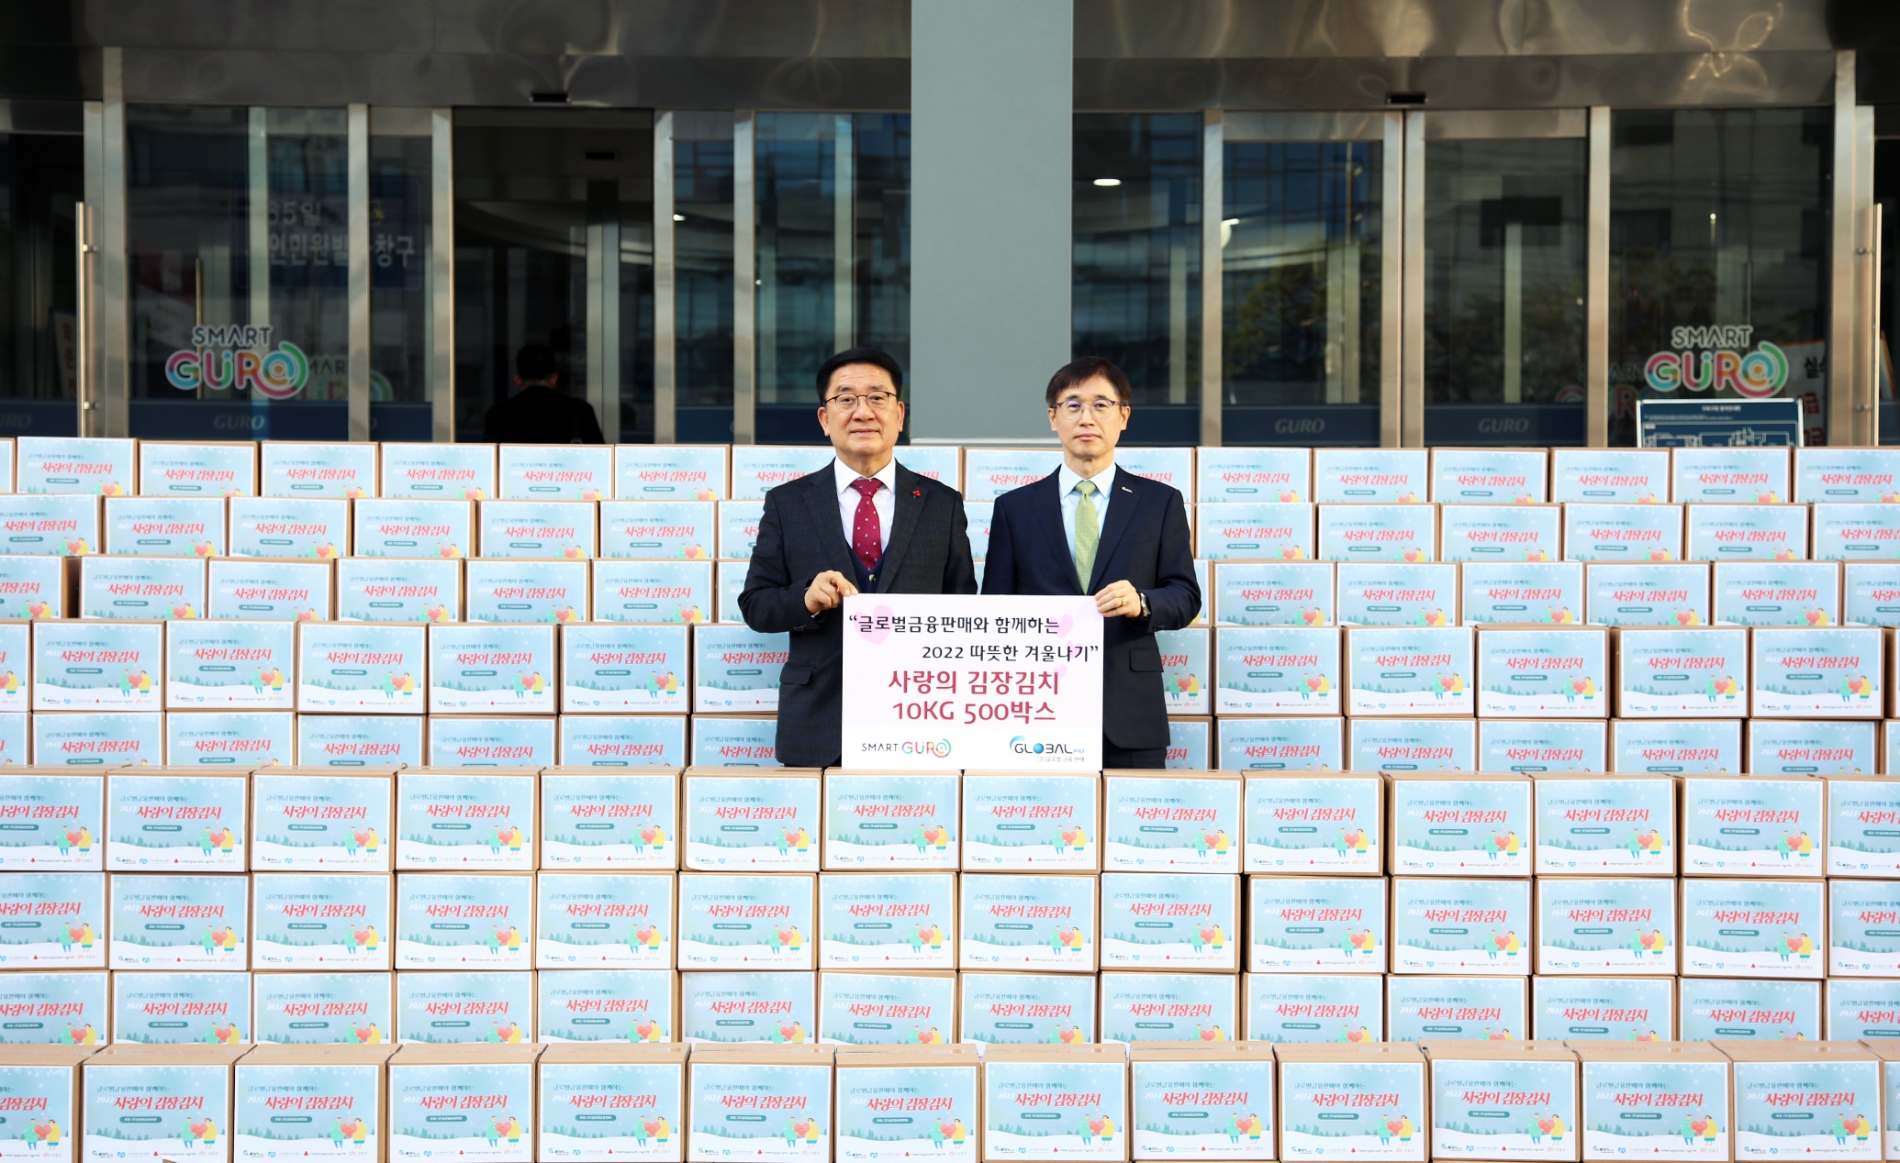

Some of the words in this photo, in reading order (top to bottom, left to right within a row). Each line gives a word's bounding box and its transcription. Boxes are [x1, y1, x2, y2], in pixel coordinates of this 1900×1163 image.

[192, 325, 273, 347] SMART
[1671, 325, 1754, 349] SMART
[213, 413, 266, 431] GURO
[1274, 417, 1326, 434] GURO
[1477, 417, 1529, 434] GURO
[849, 615, 989, 634] “글로벌금융판매와
[994, 616, 1060, 635] 함께하는
[921, 646, 964, 660] 2022
[970, 645, 1019, 662] 따뜻한
[1024, 645, 1099, 663] 겨울나기”
[888, 670, 958, 695] 사랑의
[967, 670, 1060, 696] 김장김치
[892, 700, 955, 721] 10KG
[963, 701, 1057, 725] 500박스
[861, 742, 899, 753] SMART
[137, 806, 175, 819] 사랑의
[175, 807, 223, 820] 김장김치
[427, 805, 464, 817] 사랑의
[464, 805, 511, 818] 김장김치
[570, 805, 607, 817] 사랑의
[607, 805, 653, 818] 김장김치
[854, 805, 890, 817] 사랑의
[891, 805, 937, 818] 김장김치
[991, 806, 1027, 818] 사랑의
[1028, 806, 1074, 819] 김장김치
[1273, 808, 1309, 821] 사랑의
[1310, 808, 1357, 821] 김장김치
[1423, 810, 1461, 823] 사랑의
[1461, 811, 1508, 824] 김장김치
[1715, 810, 1752, 822] 사랑의
[1753, 810, 1800, 823] 김장김치
[140, 906, 177, 918] 사랑의
[177, 906, 225, 919] 김장김치
[426, 905, 462, 917] 사랑의
[463, 906, 509, 918] 김장김치
[566, 904, 603, 917] 사랑의
[603, 904, 649, 917] 김장김치
[849, 905, 885, 917] 사랑의
[885, 904, 931, 917] 김장김치
[989, 905, 1026, 917] 사랑의
[1026, 906, 1072, 919] 김장김치
[1280, 909, 1317, 921] 사랑의
[1317, 909, 1363, 922] 김장김치
[1424, 910, 1461, 923] 사랑의
[1461, 910, 1507, 923] 김장김치
[1713, 911, 1751, 923] 사랑의
[1752, 912, 1800, 925] 김장김치
[143, 1003, 181, 1016] 사랑의
[181, 1003, 229, 1016] 김장김치
[426, 1003, 463, 1015] 사랑의
[463, 1002, 510, 1015] 김장김치
[566, 1000, 603, 1012] 사랑의
[603, 1000, 649, 1013] 김장김치
[848, 1004, 885, 1017] 사랑의
[885, 1006, 931, 1019] 김장김치
[989, 1004, 1026, 1017] 사랑의
[1027, 1005, 1073, 1018] 김장김치
[1276, 1004, 1313, 1017] 사랑의
[1313, 1005, 1360, 1018] 김장김치
[1417, 1008, 1454, 1020] 사랑의
[1455, 1008, 1502, 1021] 김장김치
[1709, 1010, 1747, 1023] 사랑의
[1748, 1011, 1796, 1024] 김장김치
[115, 1097, 153, 1110] 사랑의
[154, 1097, 204, 1111] 김장김치
[265, 1097, 304, 1110] 사랑의
[305, 1097, 354, 1110] 김장김치
[420, 1096, 459, 1109] 사랑의
[459, 1096, 508, 1109] 김장김치
[570, 1095, 608, 1108] 사랑의
[609, 1095, 657, 1109] 김장김치
[721, 1096, 759, 1109] 사랑의
[759, 1096, 807, 1109] 김장김치
[867, 1098, 905, 1111] 사랑의
[905, 1098, 953, 1111] 김장김치
[1015, 1094, 1053, 1107] 사랑의
[1054, 1094, 1102, 1107] 김장김치
[1162, 1093, 1200, 1106] 사랑의
[1201, 1092, 1249, 1106] 김장김치
[1312, 1094, 1351, 1107] 사랑의
[1351, 1094, 1400, 1107] 김장김치
[1462, 1091, 1501, 1105] 사랑의
[1502, 1092, 1551, 1106] 김장김치
[1614, 1093, 1653, 1107] 사랑의
[1654, 1094, 1704, 1107] 김장김치
[1765, 1093, 1805, 1107] 사랑의
[1806, 1093, 1856, 1107] 김장김치
